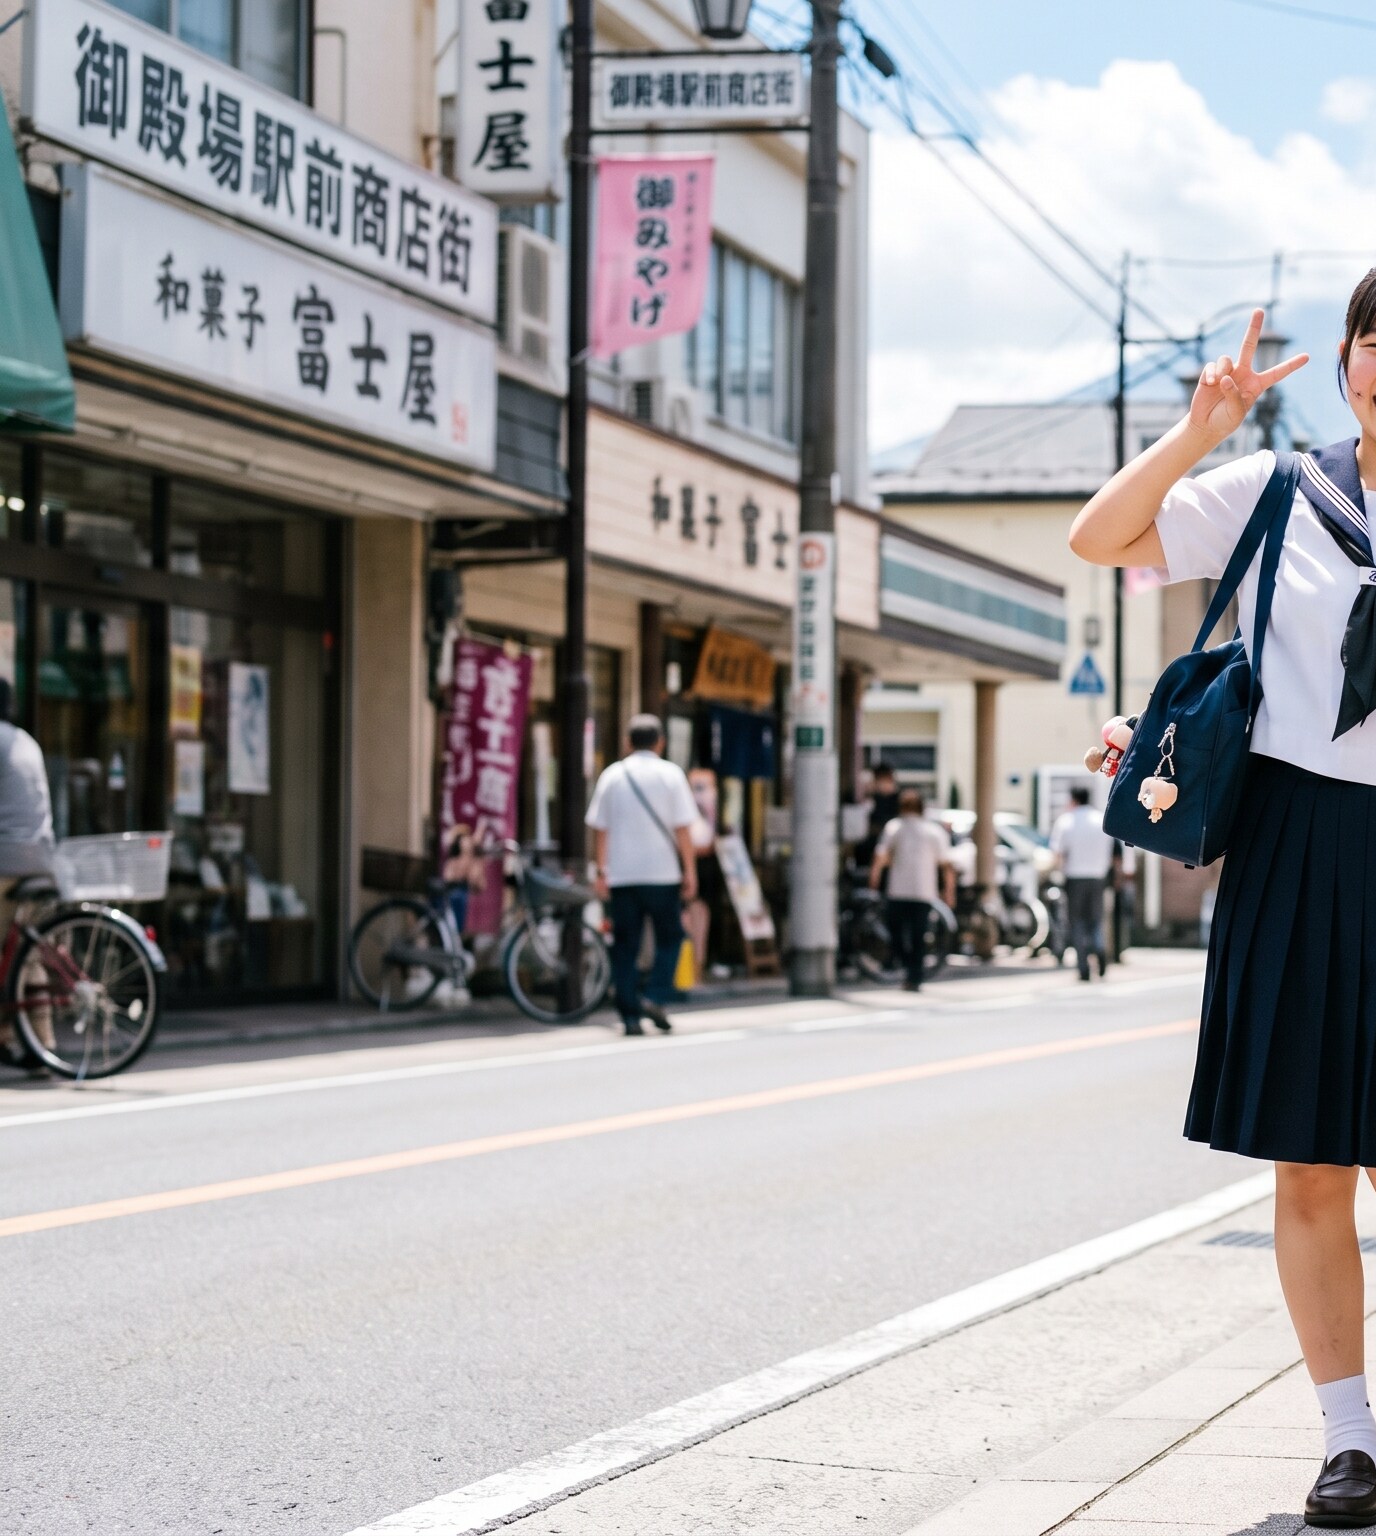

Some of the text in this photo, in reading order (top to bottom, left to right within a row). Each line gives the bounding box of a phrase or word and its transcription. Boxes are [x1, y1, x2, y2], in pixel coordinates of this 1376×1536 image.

[74, 22, 472, 295] 御殿場駅前商店街
[156, 250, 437, 427] 和菓子 富士屋
